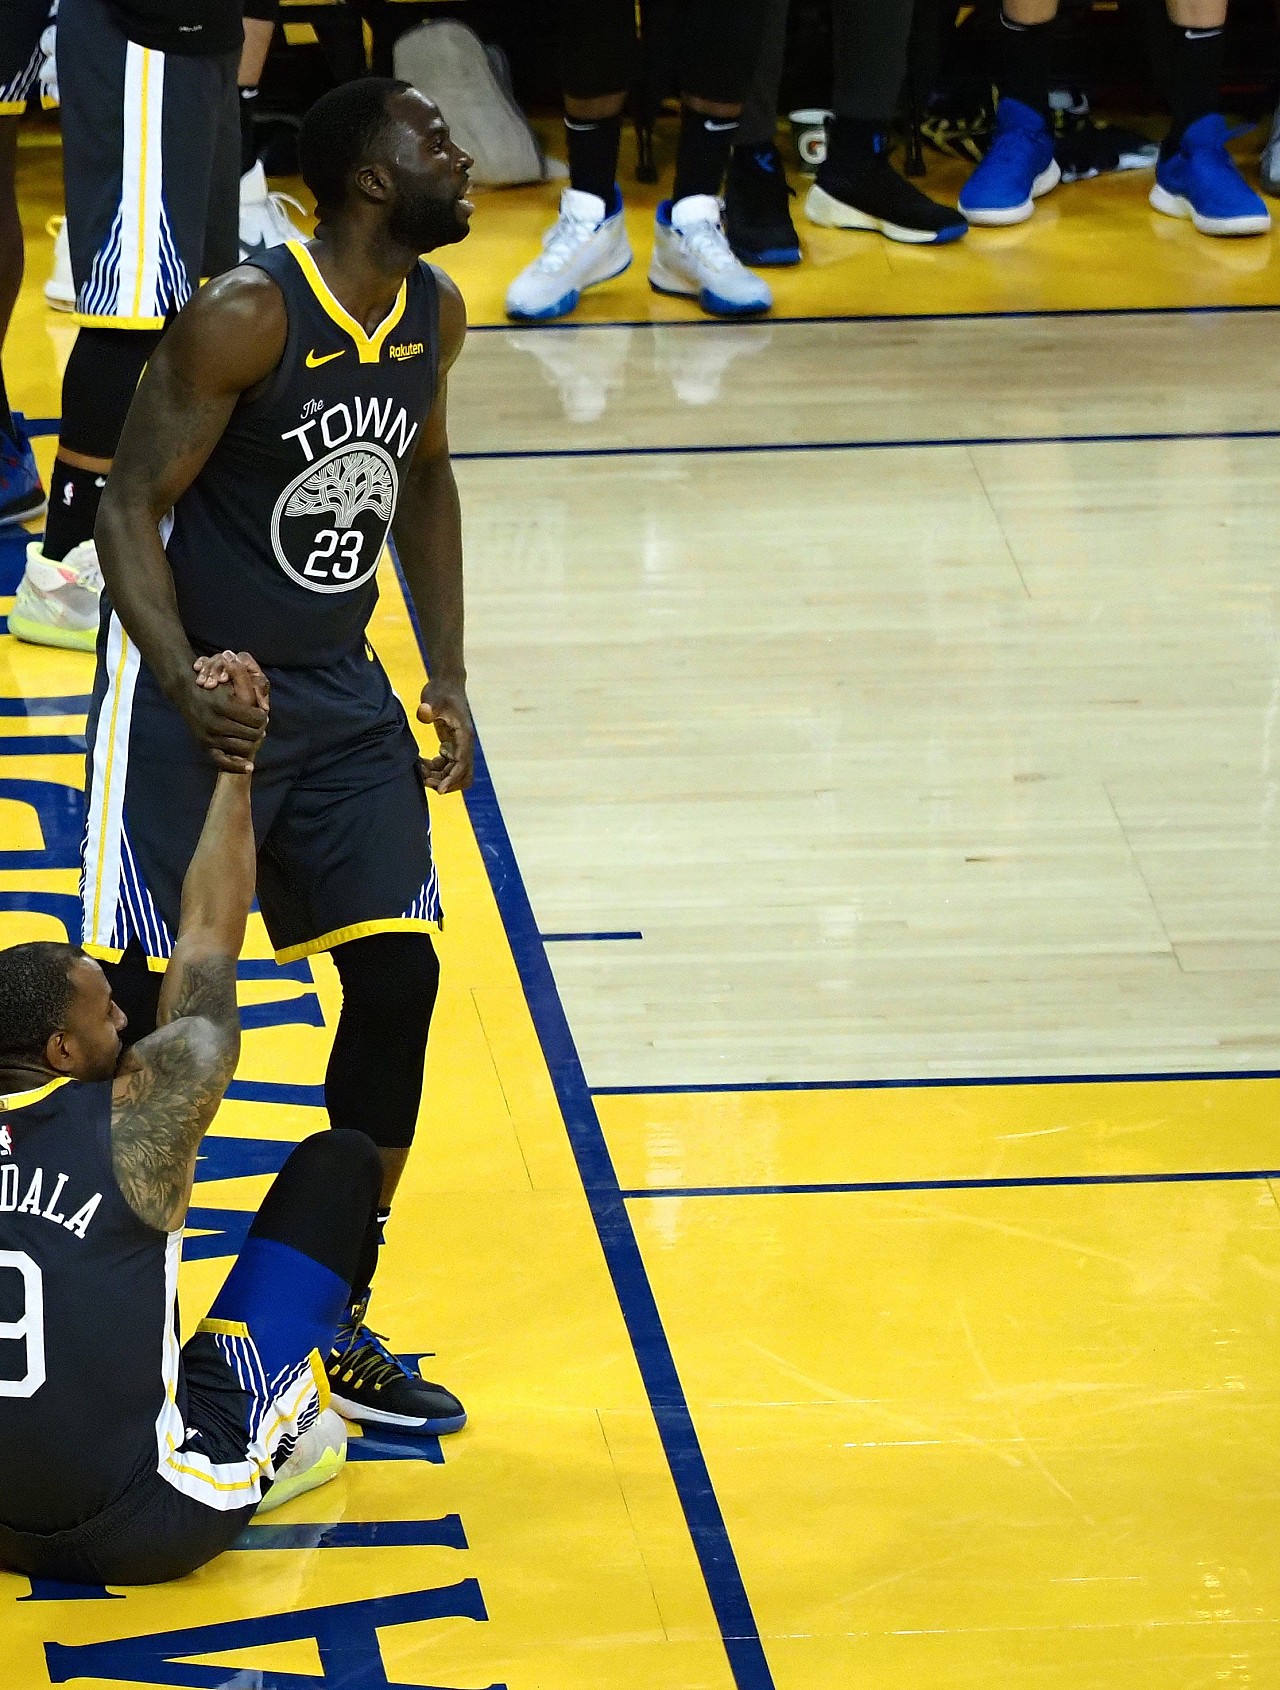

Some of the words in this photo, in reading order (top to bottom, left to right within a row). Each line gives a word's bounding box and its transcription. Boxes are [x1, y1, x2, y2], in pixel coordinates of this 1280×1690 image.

[389, 342, 424, 362] Rakuten
[300, 398, 325, 419] The
[281, 396, 418, 461] TOWN
[303, 529, 365, 580] 23
